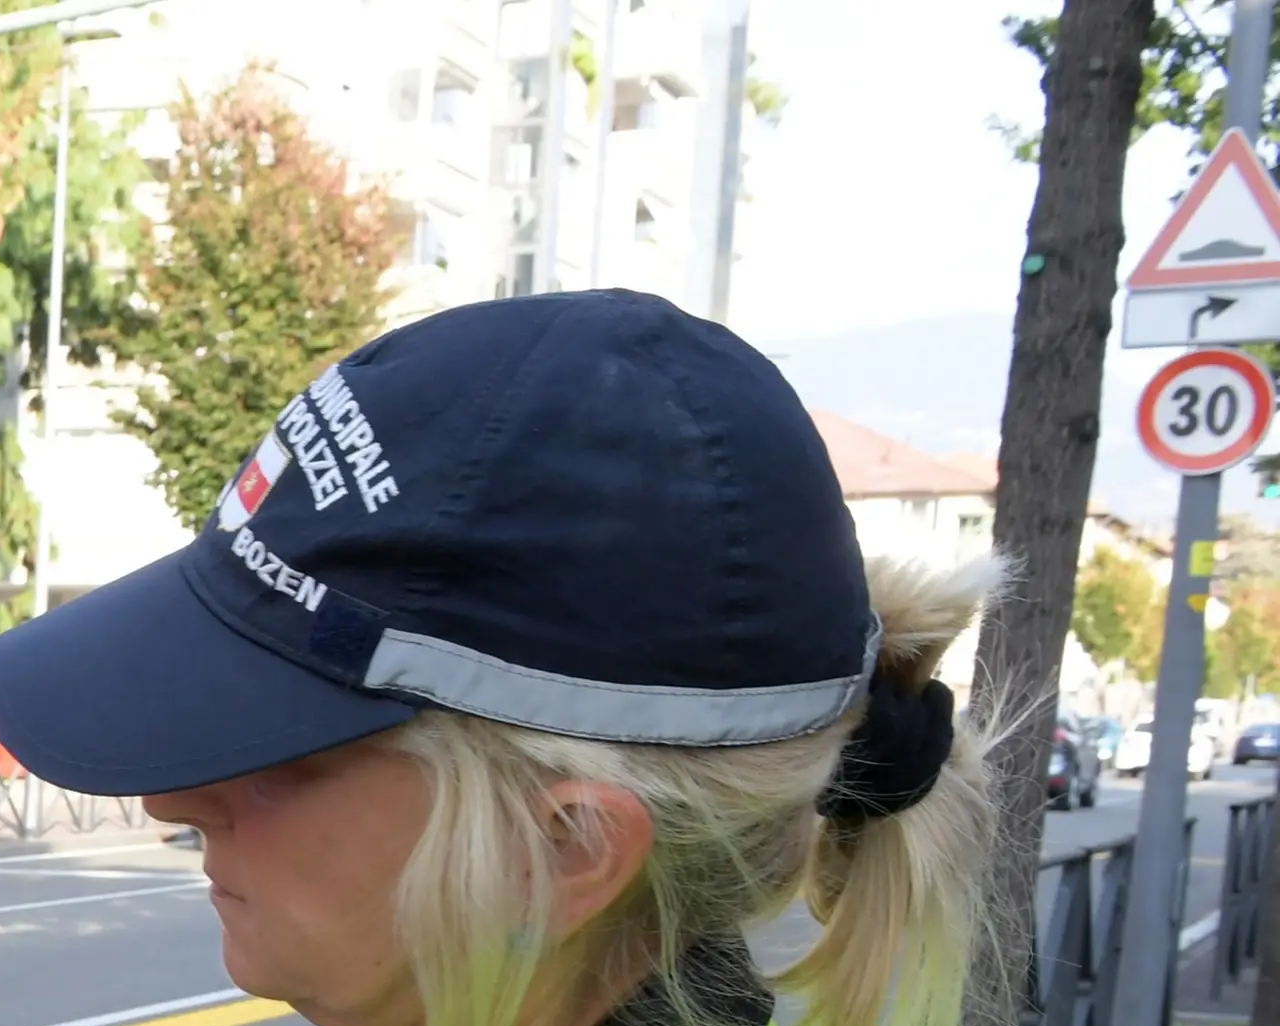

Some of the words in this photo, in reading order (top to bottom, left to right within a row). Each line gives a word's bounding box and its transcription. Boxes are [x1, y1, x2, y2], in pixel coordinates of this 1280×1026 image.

[307, 362, 401, 514] UNICIPALE
[1168, 384, 1239, 437] 30
[231, 525, 329, 612] BOZEN
